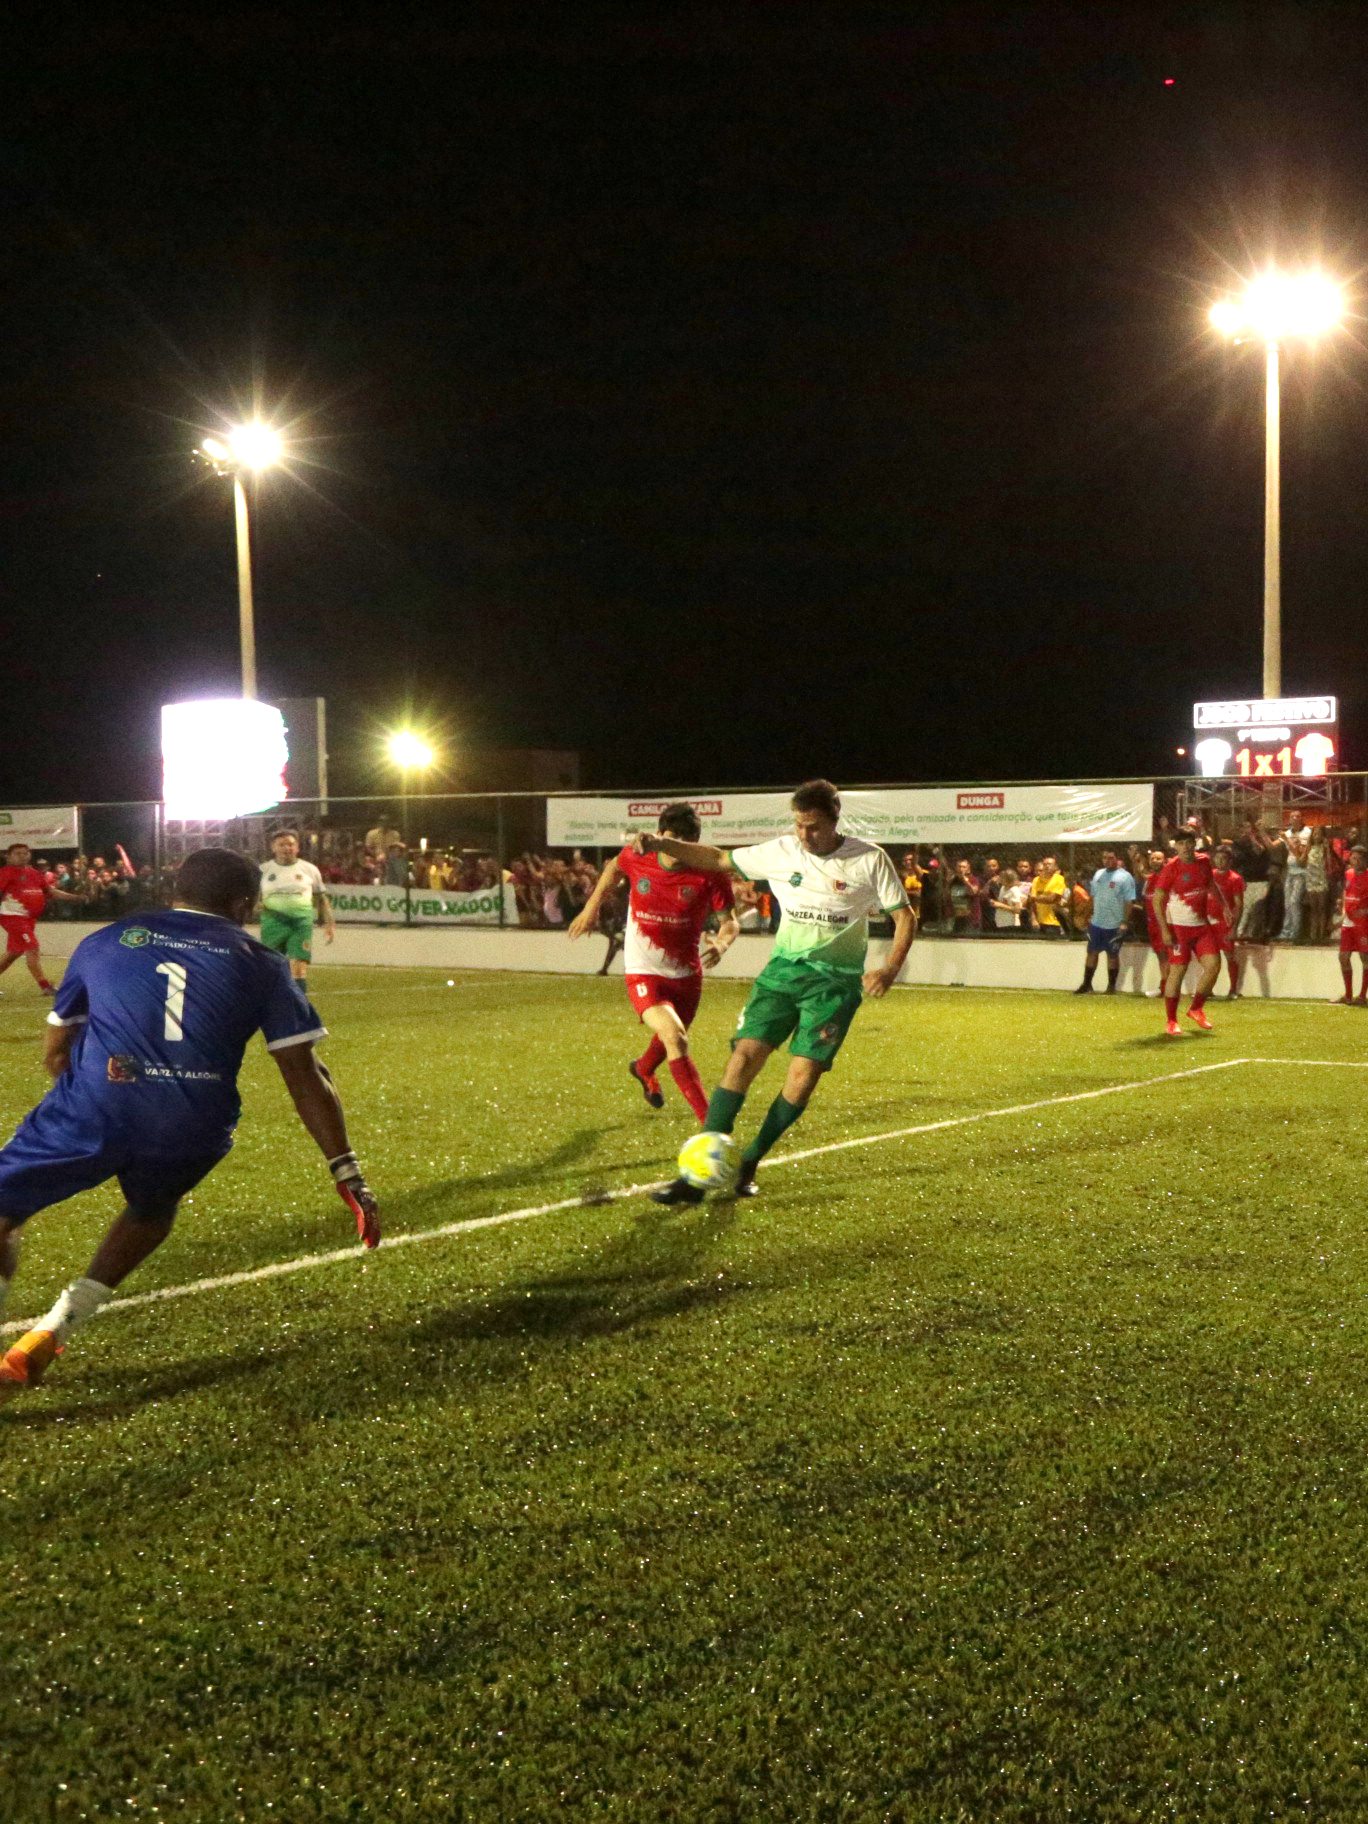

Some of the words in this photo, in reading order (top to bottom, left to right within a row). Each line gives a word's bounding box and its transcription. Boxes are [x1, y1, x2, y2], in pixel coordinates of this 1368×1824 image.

[960, 796, 1000, 807] DUNGA
[917, 813, 957, 823] amizade
[967, 811, 1032, 823] consideração
[1035, 813, 1055, 823] que
[387, 896, 505, 915] GOVERNADOR
[155, 961, 187, 1042] 1
